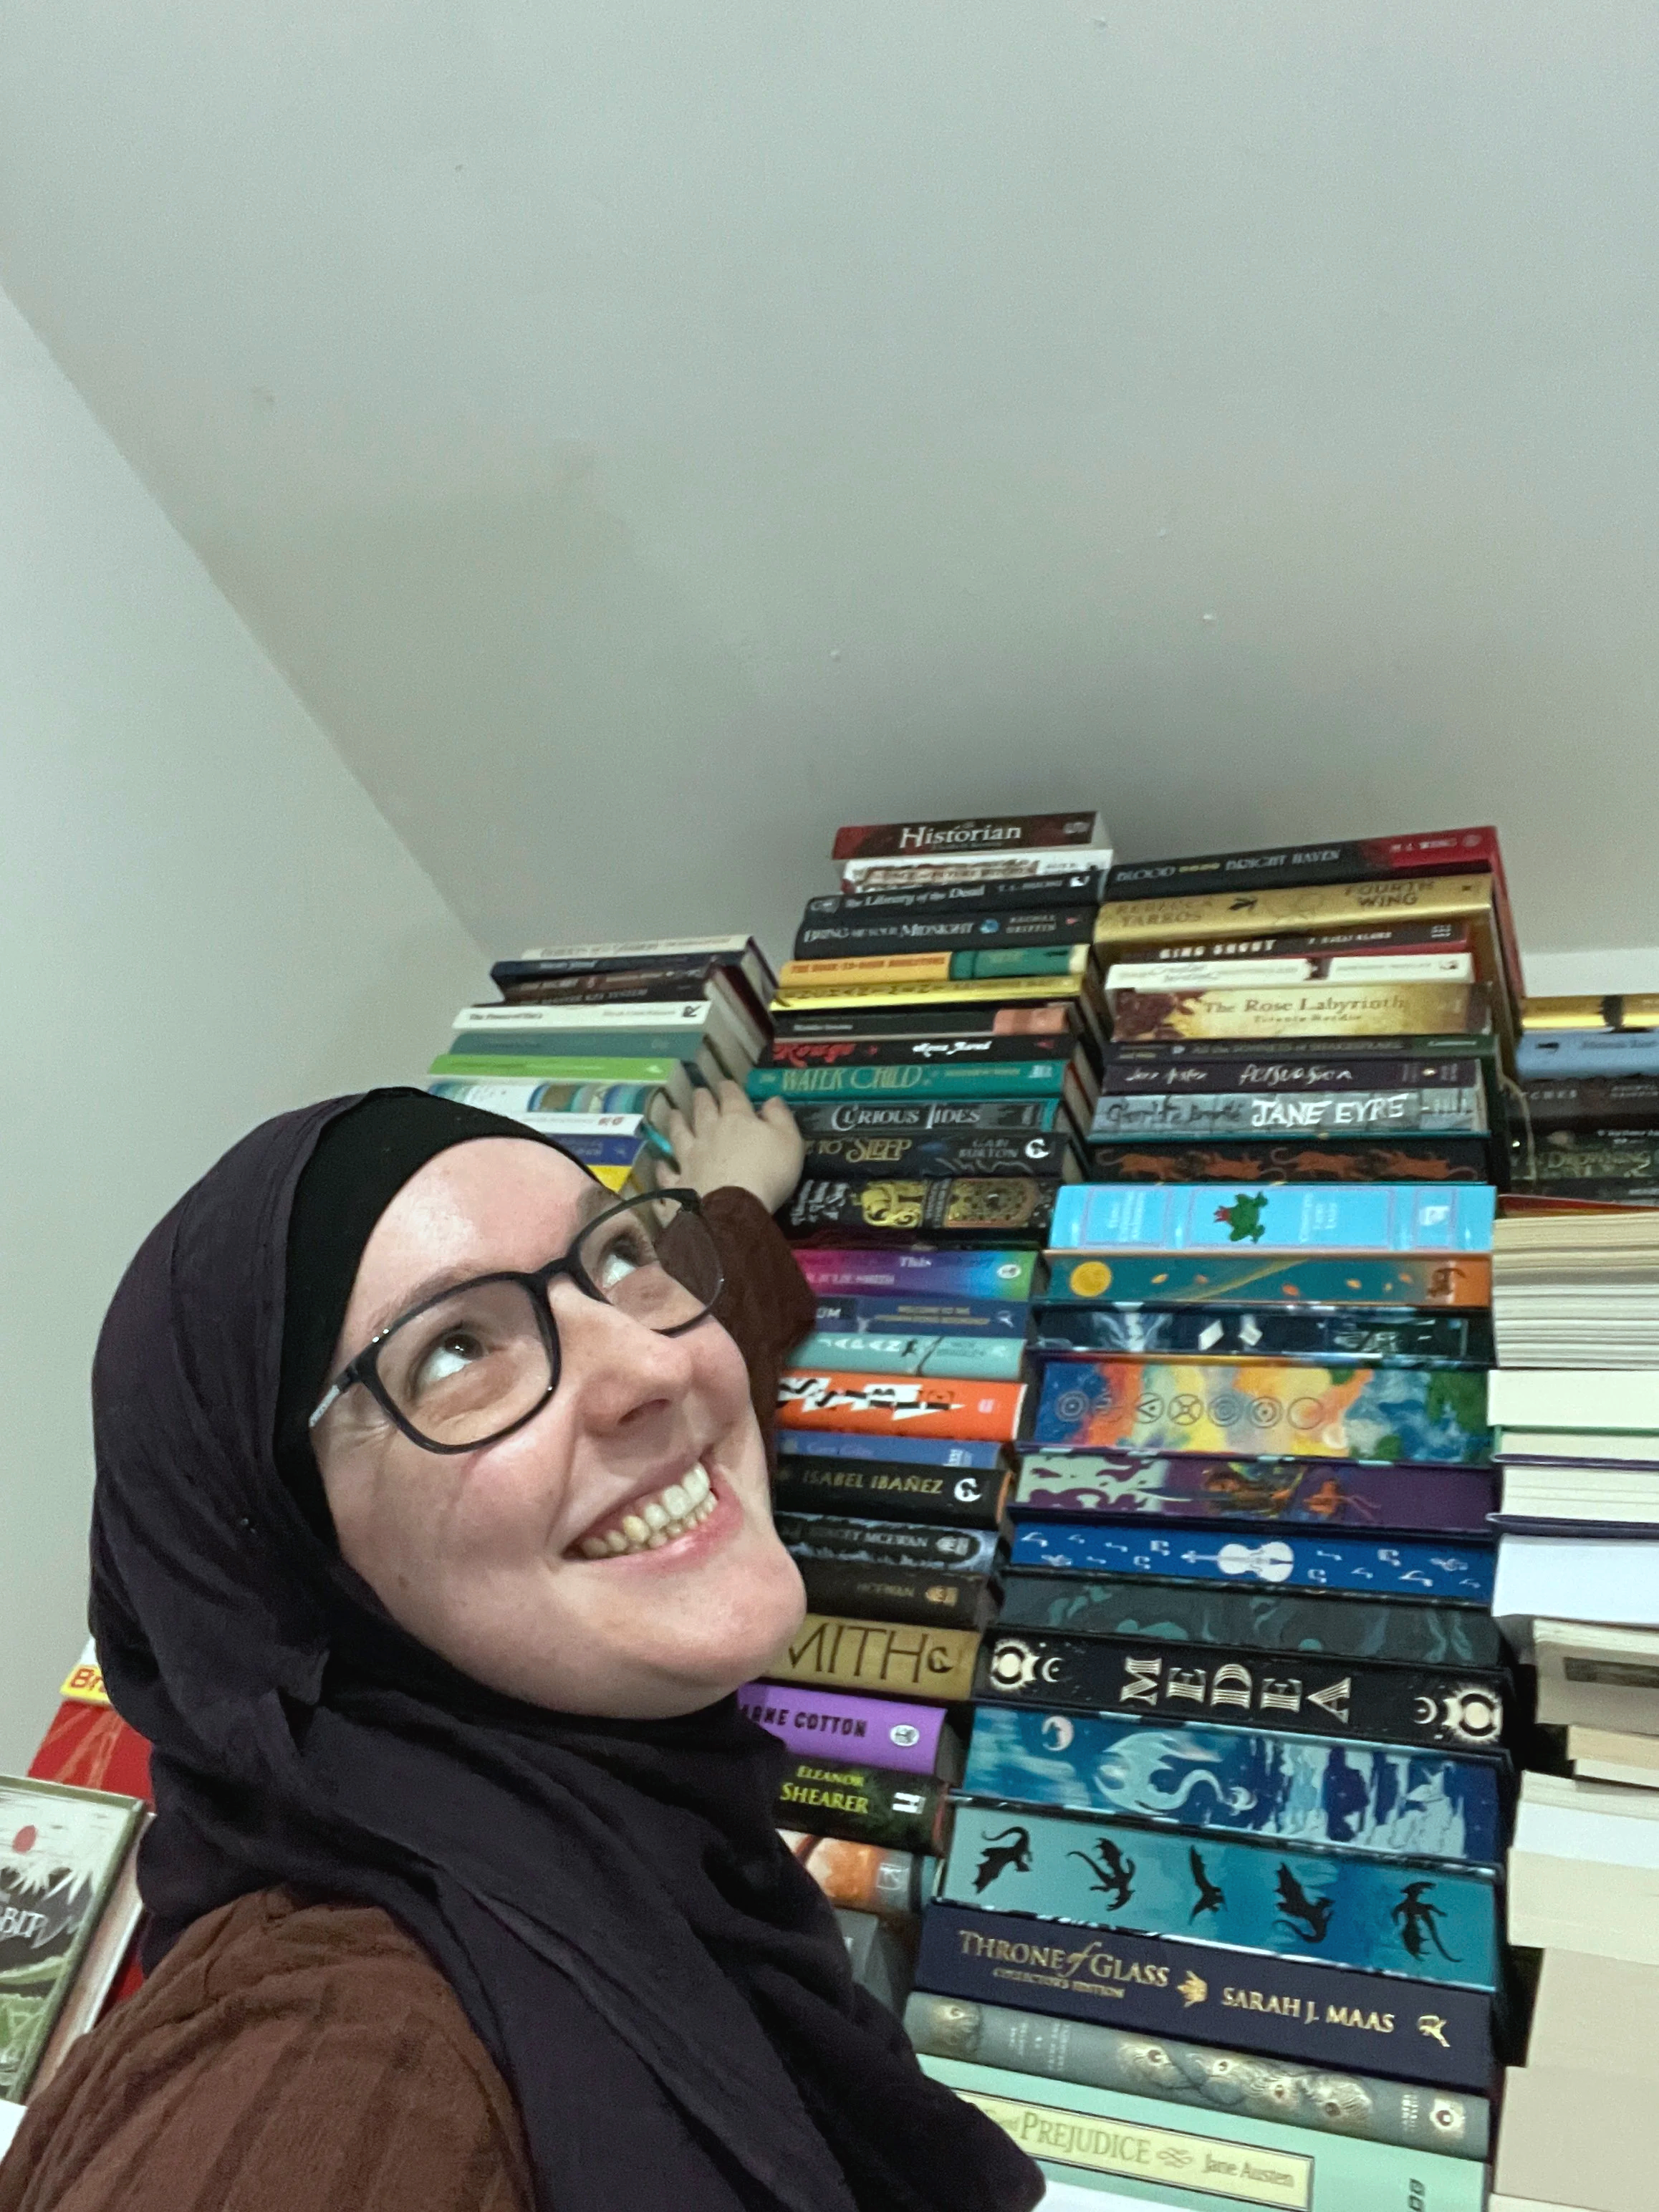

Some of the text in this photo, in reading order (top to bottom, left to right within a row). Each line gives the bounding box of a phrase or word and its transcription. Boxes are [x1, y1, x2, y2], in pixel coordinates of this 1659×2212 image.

[899, 825, 1021, 849] Historian
[1358, 892, 1418, 907] WING
[1244, 999, 1293, 1012] Rose
[1299, 995, 1405, 1014] Labyrinth
[831, 1103, 981, 1132] CURIOUS TIDES
[1251, 1093, 1409, 1127] JANE EYRE
[845, 1138, 913, 1163] SLEEP
[802, 1471, 944, 1494] ISABEL IBAÑEZ
[1120, 1654, 1352, 1723] MEDEA
[794, 1712, 867, 1737] COTTON
[797, 1765, 865, 1787] ELEANOR
[779, 1782, 869, 1814] SHEARER
[959, 1930, 1170, 1988] THRONE of GLASS
[1221, 1986, 1396, 2034] SARAH J. MAAS
[1020, 2110, 1152, 2164] PREJUDICE
[1202, 2150, 1238, 2176] Jane
[1239, 2161, 1295, 2188] Austen
